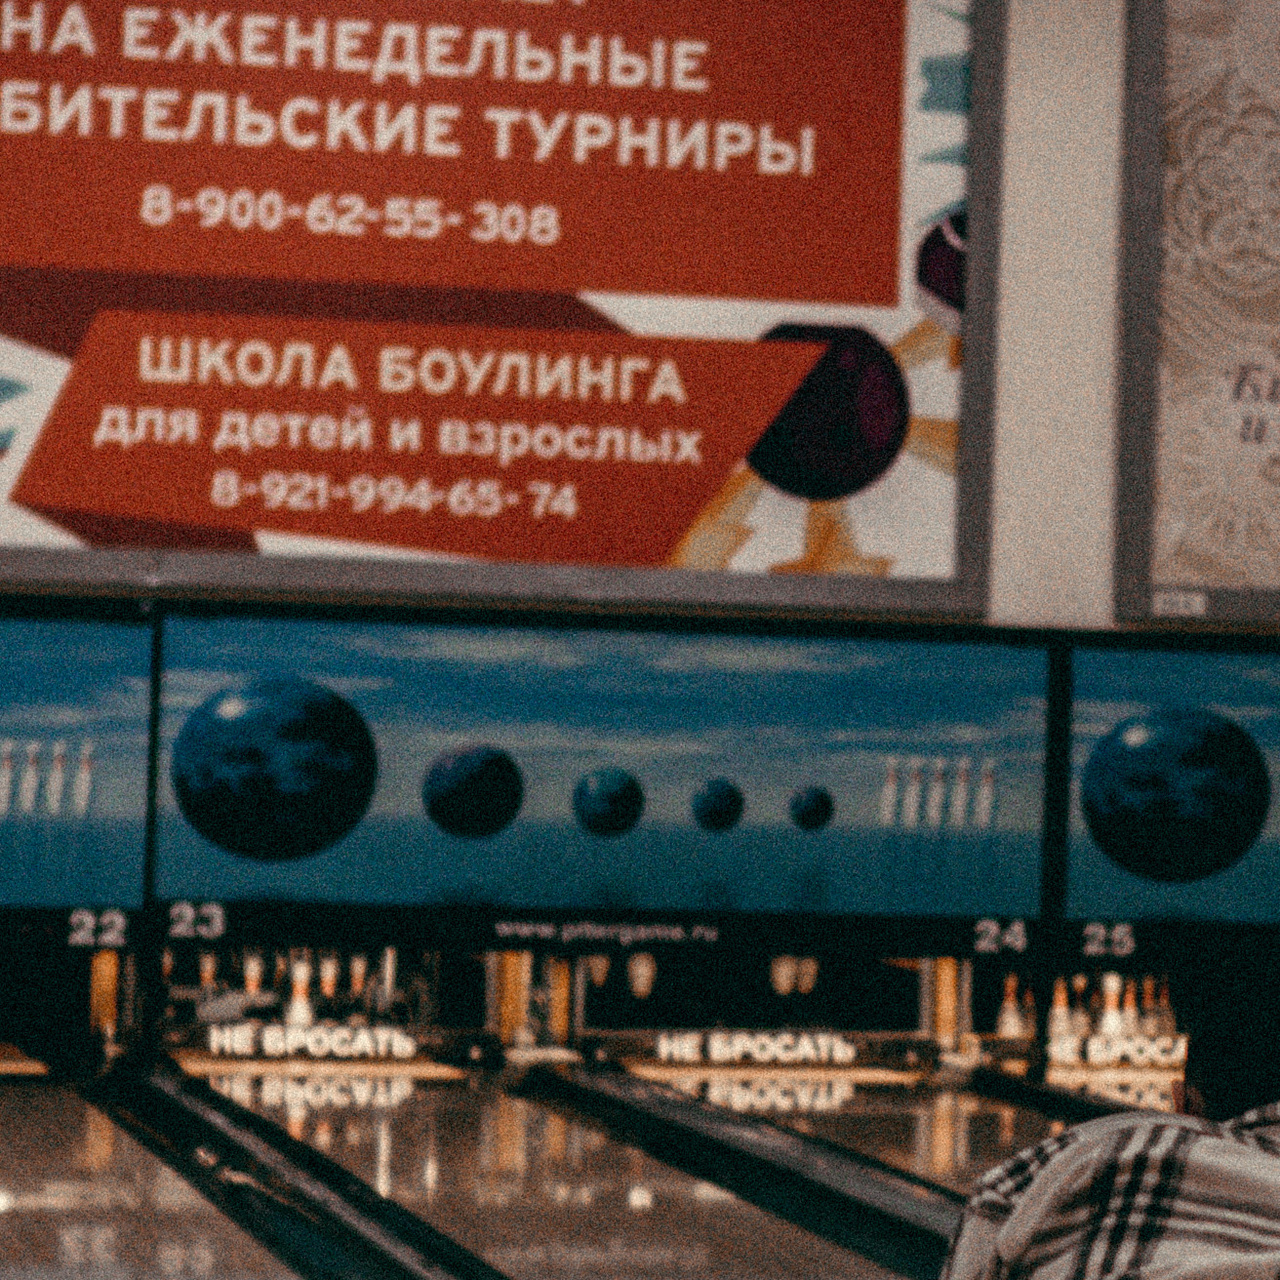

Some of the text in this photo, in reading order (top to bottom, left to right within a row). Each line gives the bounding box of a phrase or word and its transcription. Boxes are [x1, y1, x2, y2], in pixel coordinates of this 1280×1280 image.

[122, 5, 710, 92] ЕЖЕНЕДЕЛЬНЫЕ
[0, 78, 816, 177] БИТЕЛЬСКИЕ ТУРНИРЫ
[139, 183, 561, 246] 8-900-62-55-308
[138, 335, 688, 404] ШКОЛА БОУЛИНГА
[214, 404, 371, 453] детей
[438, 420, 702, 466] взрослых
[68, 901, 226, 946] 22 23
[974, 919, 1136, 956] 24 25
